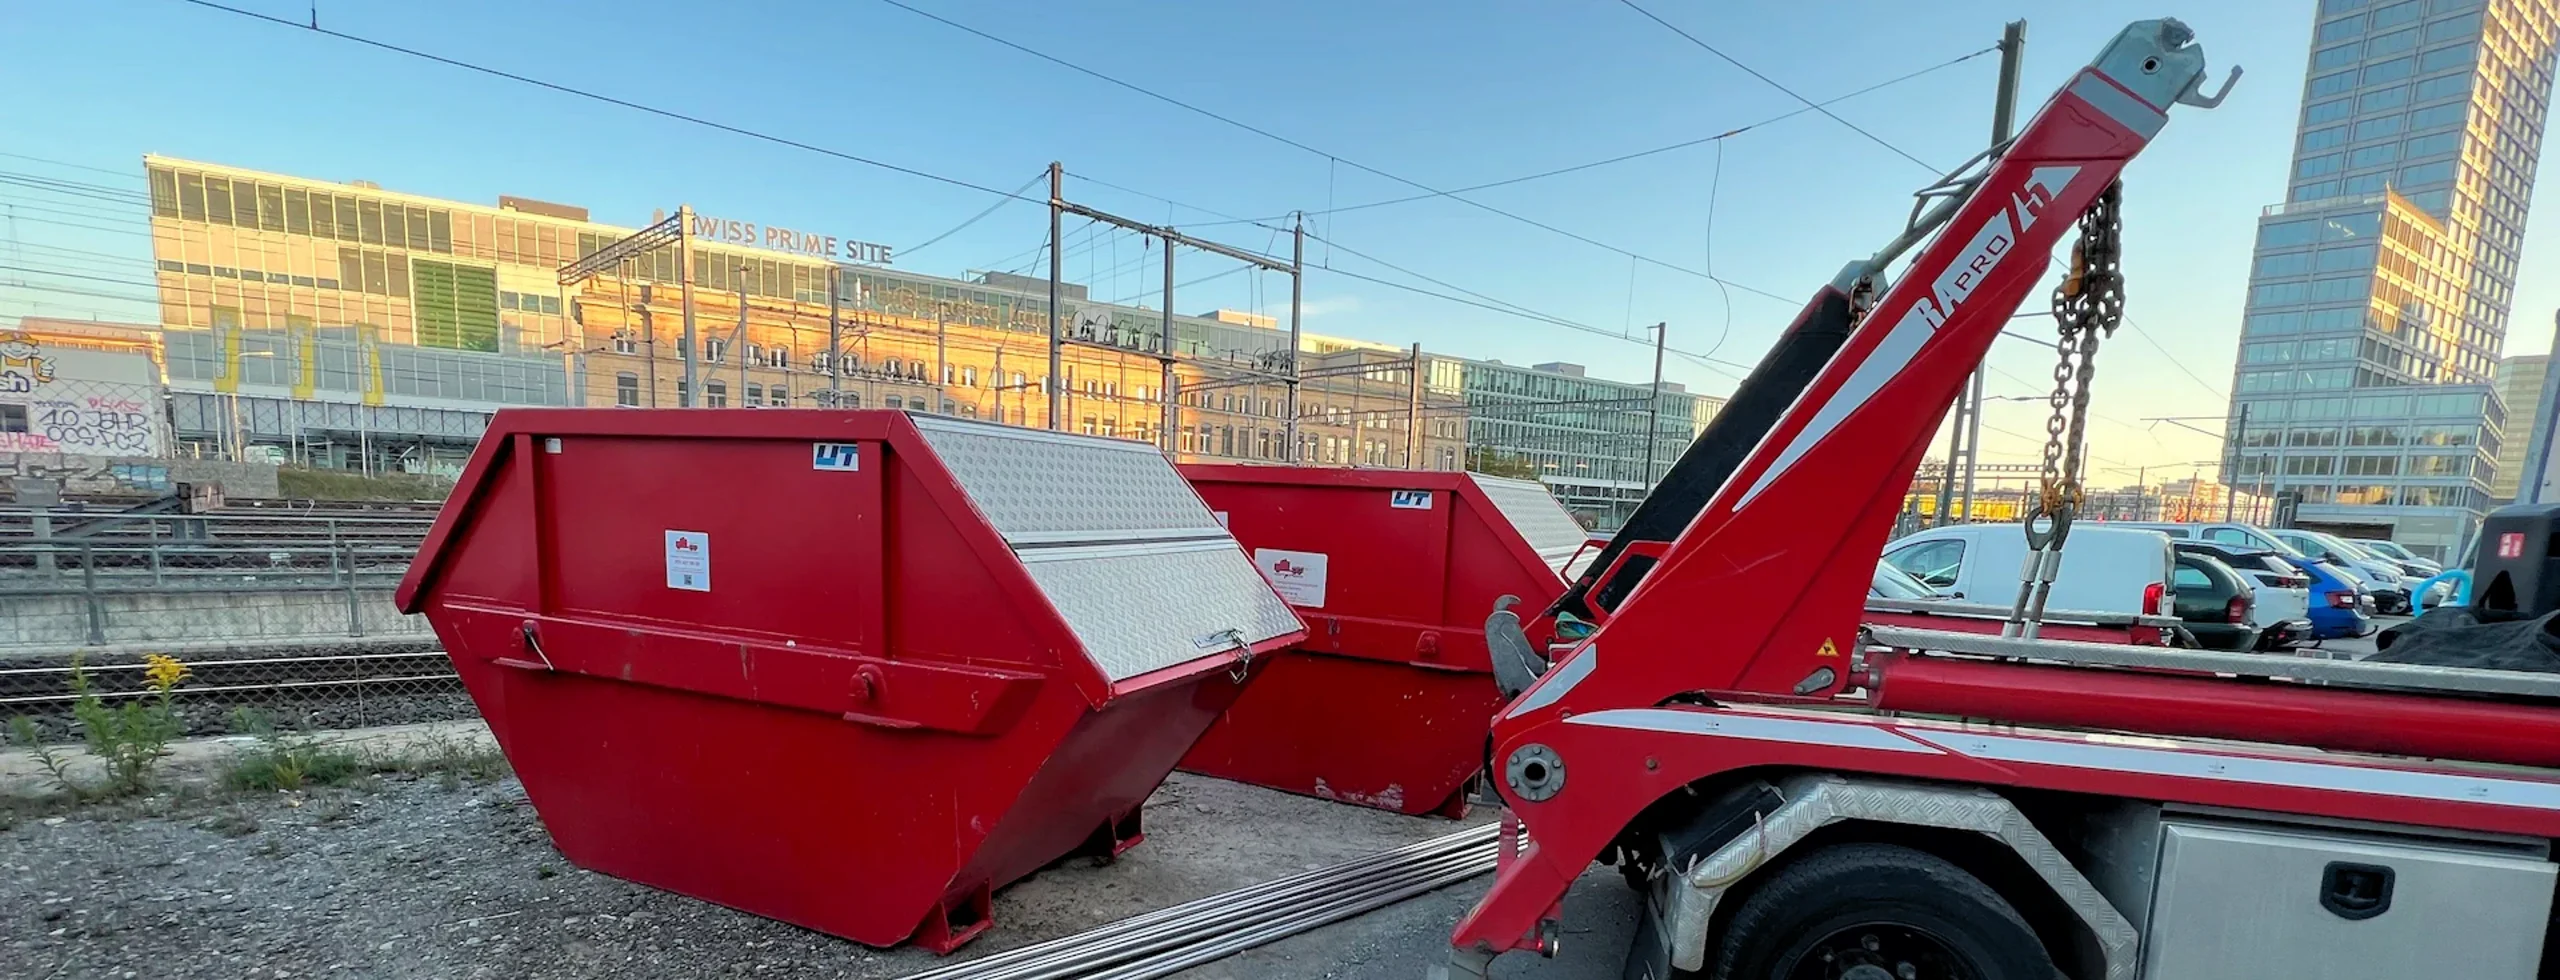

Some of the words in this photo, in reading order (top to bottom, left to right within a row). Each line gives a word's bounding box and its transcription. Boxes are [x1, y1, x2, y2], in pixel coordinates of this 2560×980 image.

[693, 214, 757, 243] WISS
[765, 225, 838, 257] PRIME
[845, 239, 894, 264] SITE
[1953, 234, 2009, 292] PRO
[815, 444, 858, 467] UT
[1392, 491, 1430, 506] UT
